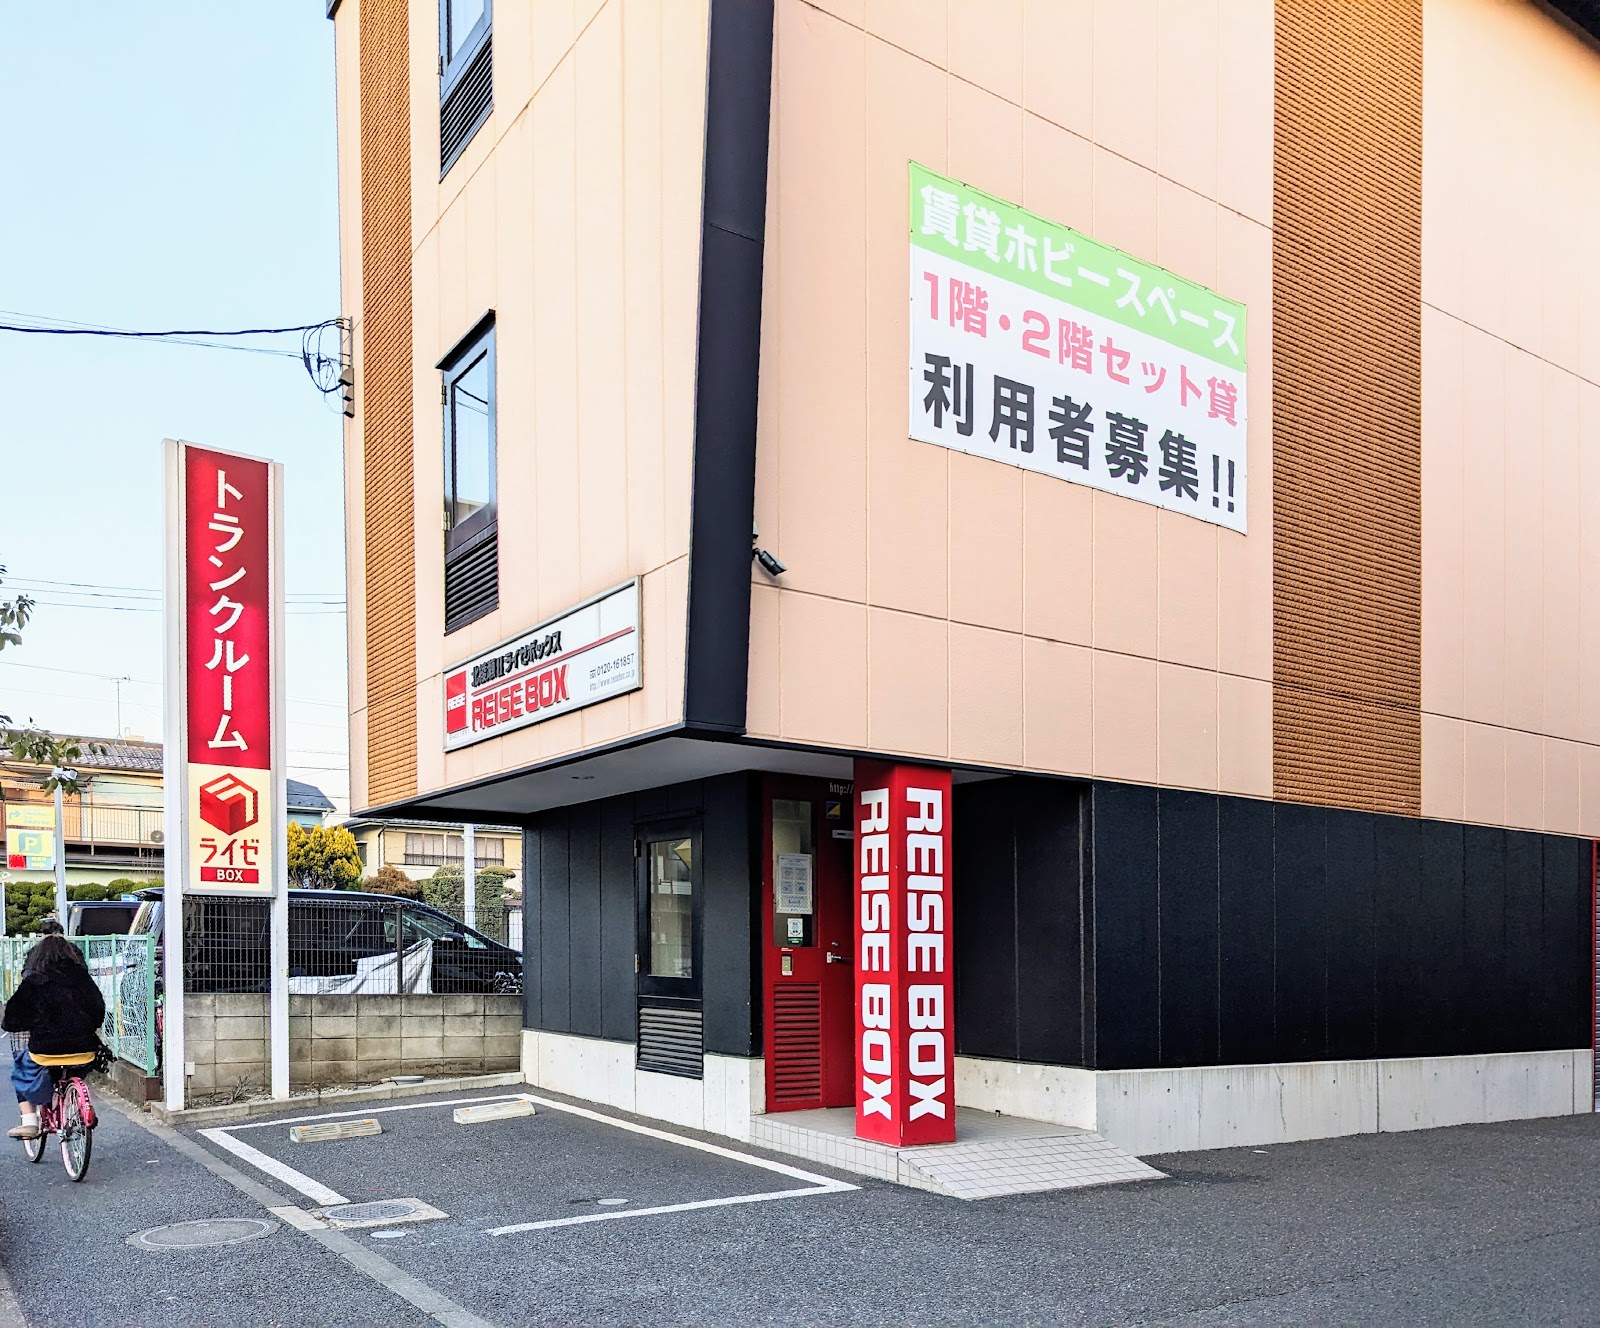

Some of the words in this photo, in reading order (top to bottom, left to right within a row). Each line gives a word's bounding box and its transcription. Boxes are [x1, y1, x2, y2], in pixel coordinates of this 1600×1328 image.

[919, 183, 1241, 356] 賃貸ホビースペース
[923, 271, 1238, 428] 1階・2階セット貸
[204, 468, 250, 753] トランクルーム
[471, 682, 524, 733] REISE
[524, 663, 570, 713] BOX
[199, 838, 260, 866] ライゼ
[216, 869, 244, 882] BOX
[860, 787, 890, 972] REISE
[906, 786, 944, 973] REISE
[861, 982, 892, 1121] BOX
[907, 984, 946, 1121] BOX
